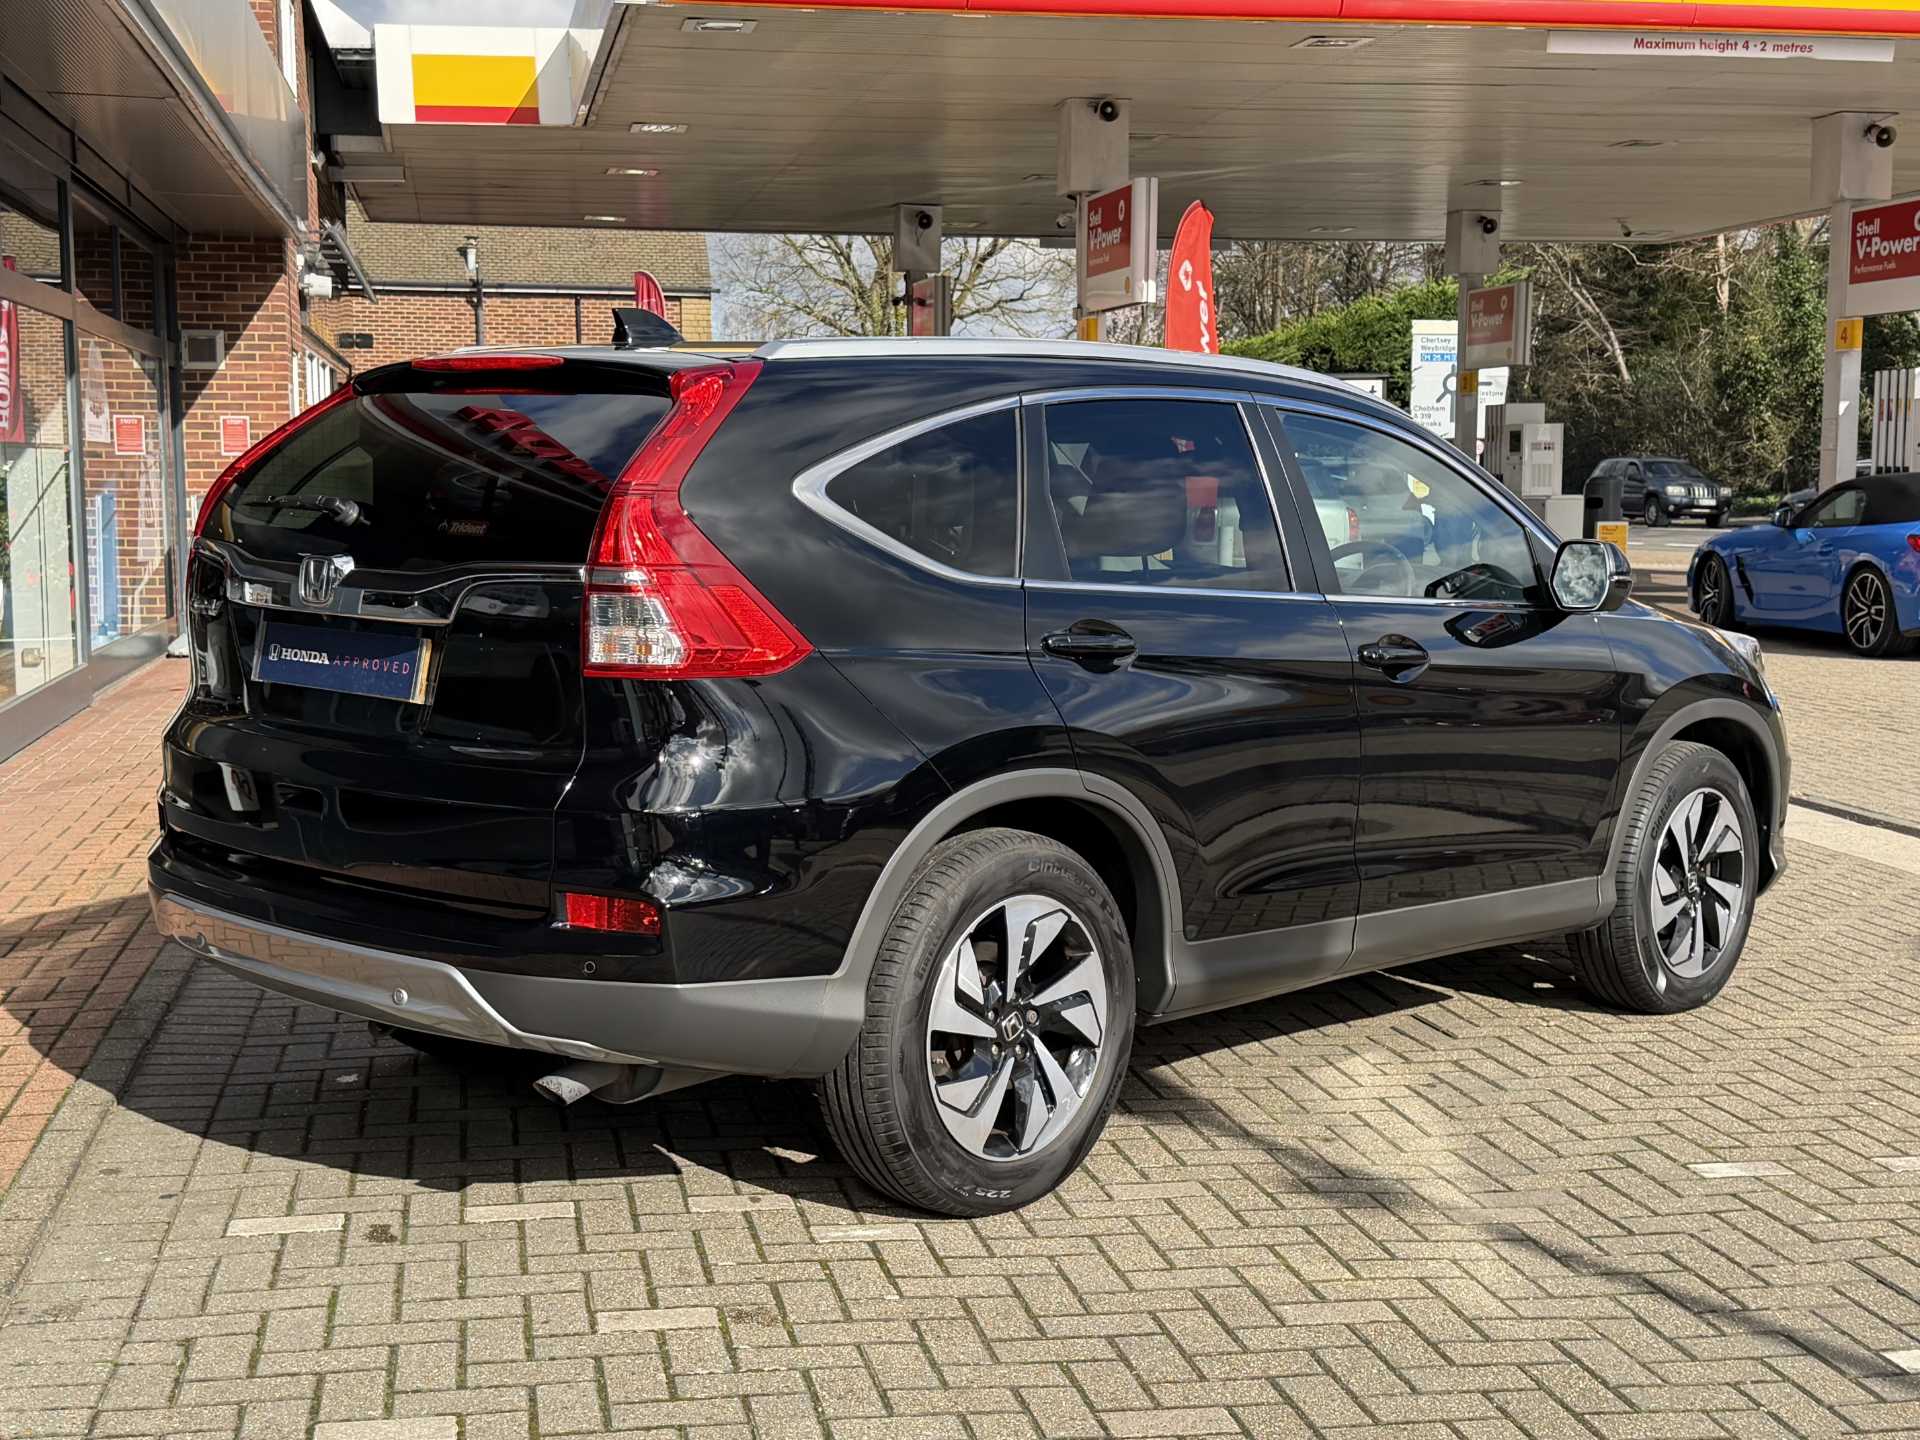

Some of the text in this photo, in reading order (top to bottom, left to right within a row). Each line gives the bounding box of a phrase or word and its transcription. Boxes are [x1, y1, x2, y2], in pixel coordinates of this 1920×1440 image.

[1633, 37, 1696, 51] Maximum
[1699, 38, 1739, 53] height
[1772, 42, 1814, 53] metres
[1089, 207, 1102, 228] Shell
[1856, 217, 1880, 237] Shell
[1089, 227, 1122, 252] V-Power
[1856, 235, 1920, 260] V-Power
[1420, 336, 1451, 344] Chertsey
[1840, 327, 1849, 344] 4
[280, 647, 410, 675] HONDA APPROVED
